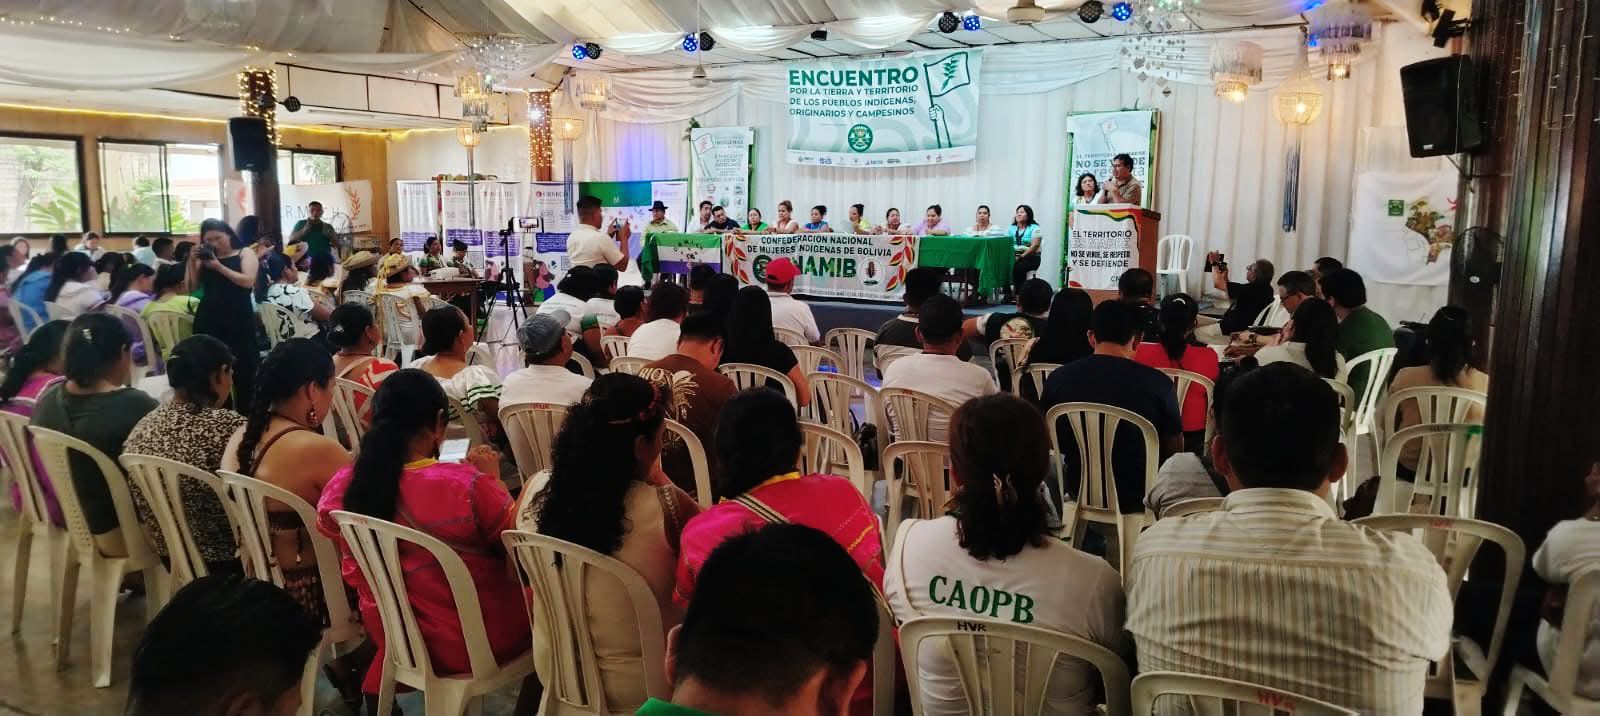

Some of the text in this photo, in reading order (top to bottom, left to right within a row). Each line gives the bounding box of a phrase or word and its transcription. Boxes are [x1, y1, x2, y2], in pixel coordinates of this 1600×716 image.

[789, 66, 919, 87] ENCUENTRO
[790, 87, 808, 95] POR
[823, 88, 854, 96] TIERRA
[864, 84, 919, 96] TERRITORIO
[790, 97, 801, 105] DE
[803, 98, 820, 106] LOS
[822, 98, 863, 107] PUEBLOS
[789, 107, 915, 118] ORIGINARIOS Y CAMPESINOS
[1075, 161, 1091, 169] NO
[1093, 160, 1107, 168] SE
[1073, 230, 1132, 238] EL TERRITORIO
[830, 236, 873, 246] NACIONAL
[747, 245, 758, 253] DE
[760, 245, 796, 255] MUJERES
[843, 246, 855, 255] DE
[857, 247, 892, 257] BOLIVIA
[1071, 250, 1078, 258] NO
[1079, 250, 1086, 258] SE
[1103, 251, 1109, 259] SE
[1079, 259, 1089, 267] SE
[1091, 260, 1129, 268] DEFIENDE
[929, 575, 1034, 624] CAOPB
[957, 621, 987, 632] HVR
